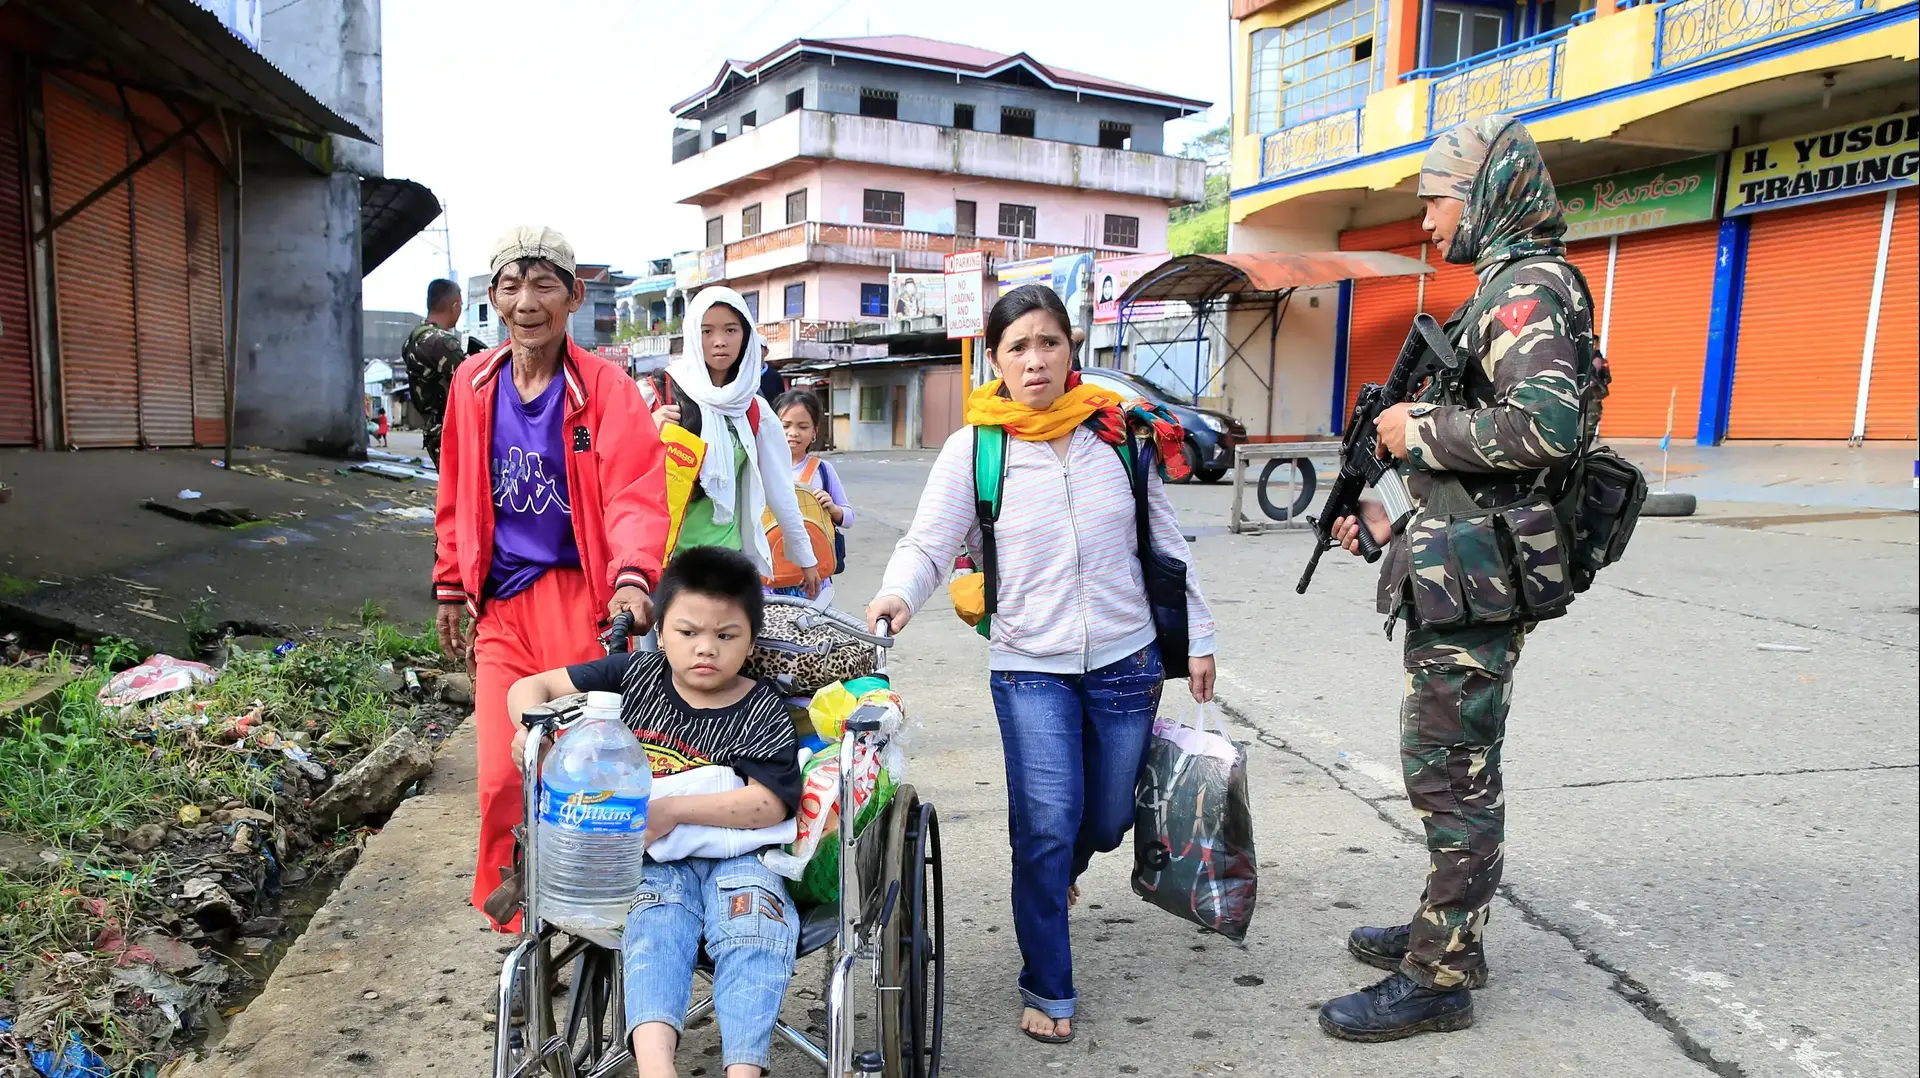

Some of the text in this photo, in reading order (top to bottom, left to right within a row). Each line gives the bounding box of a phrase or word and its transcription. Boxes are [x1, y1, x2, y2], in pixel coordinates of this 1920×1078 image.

[1742, 147, 1778, 174] H.
[1739, 151, 1918, 206] TRADING
[1591, 173, 1700, 216] Kanton
[1570, 208, 1666, 238] STAURANT
[944, 254, 981, 274] NO PARKING
[957, 279, 967, 290] NO
[951, 291, 975, 304] LOADING
[957, 305, 969, 316] AND
[949, 318, 981, 330] UNLOADING
[667, 444, 696, 466] Maggi
[492, 458, 526, 481] APPA
[560, 803, 633, 825] Wilkins
